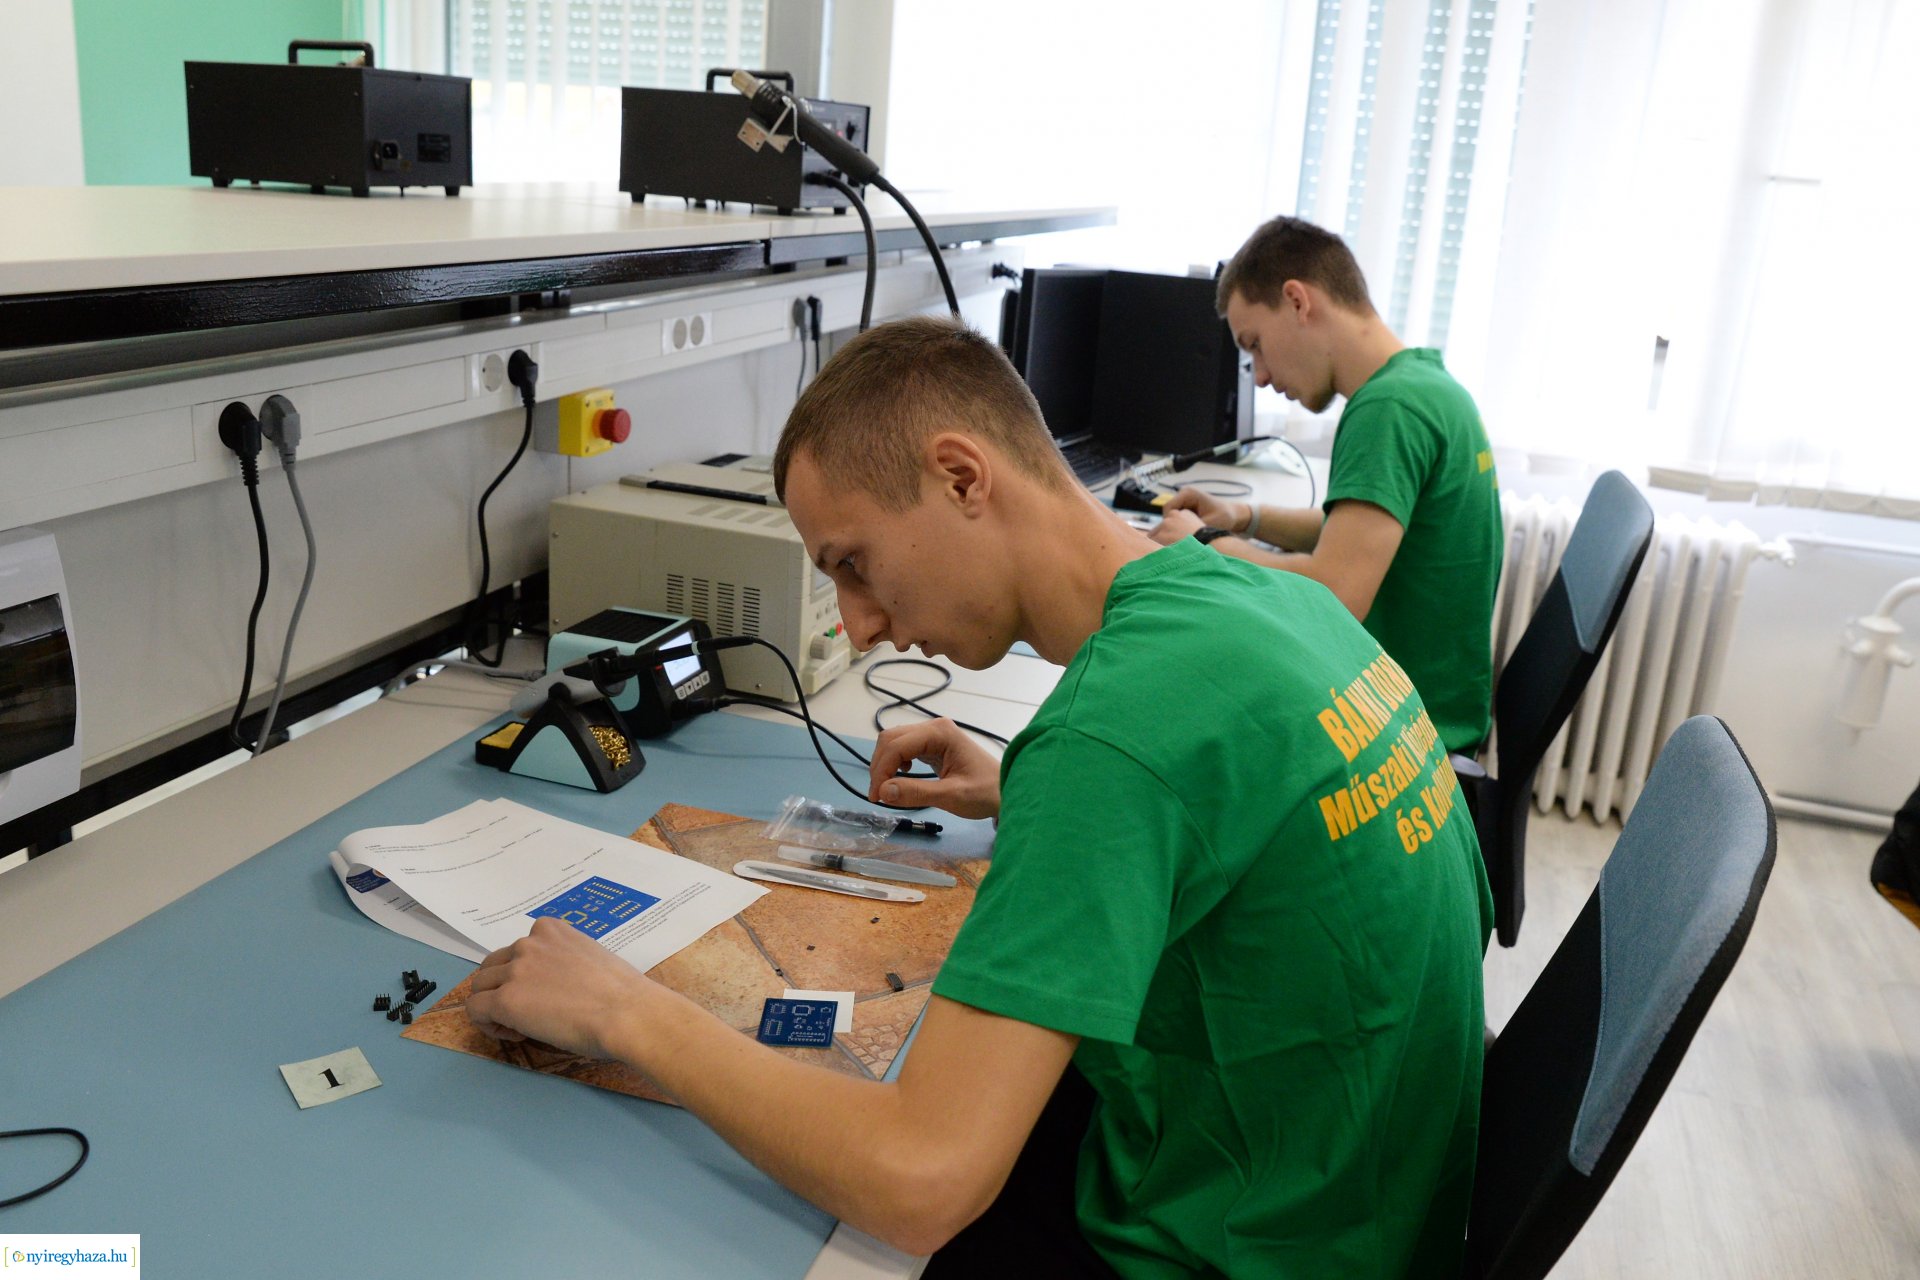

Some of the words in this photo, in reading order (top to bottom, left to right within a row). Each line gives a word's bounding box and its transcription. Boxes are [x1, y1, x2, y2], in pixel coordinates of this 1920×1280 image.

[1317, 677, 1392, 763] BÁNKI
[1318, 737, 1421, 841] Műszaki
[1396, 807, 1434, 854] és
[318, 1068, 345, 1090] 1
